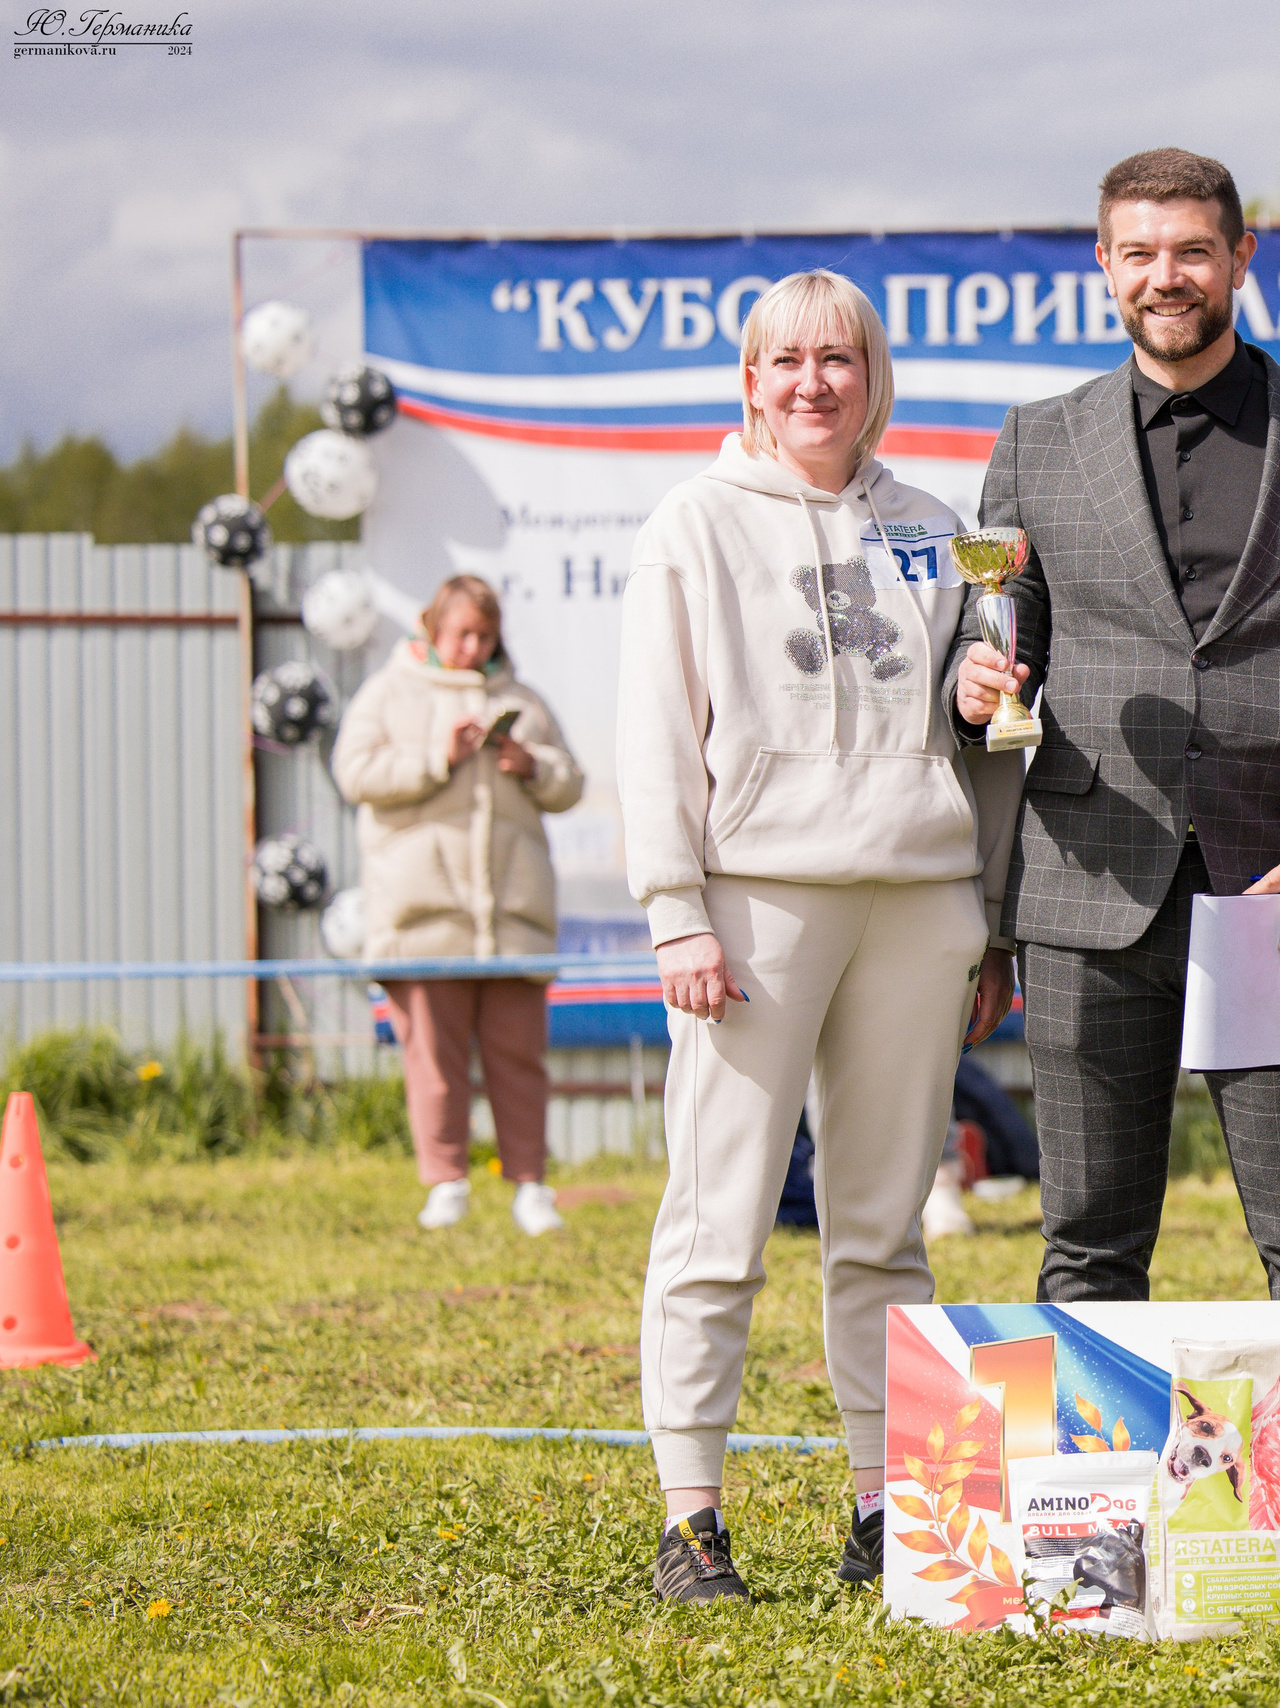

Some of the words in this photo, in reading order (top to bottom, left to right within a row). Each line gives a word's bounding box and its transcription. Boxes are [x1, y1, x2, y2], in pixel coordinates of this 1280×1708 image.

[886, 546, 938, 582] 27
[1029, 1525, 1077, 1537] BULL
[1188, 1557, 1210, 1565] 100%
[1214, 1555, 1260, 1564] BALANCE
[1206, 1584, 1222, 1593] ДЛЯ
[1223, 1583, 1266, 1592] ВЗРОСЛЫХ
[1206, 1592, 1242, 1601] КРУПНЫХ
[1243, 1591, 1271, 1599] ПОРОД
[1207, 1606, 1215, 1615] С
